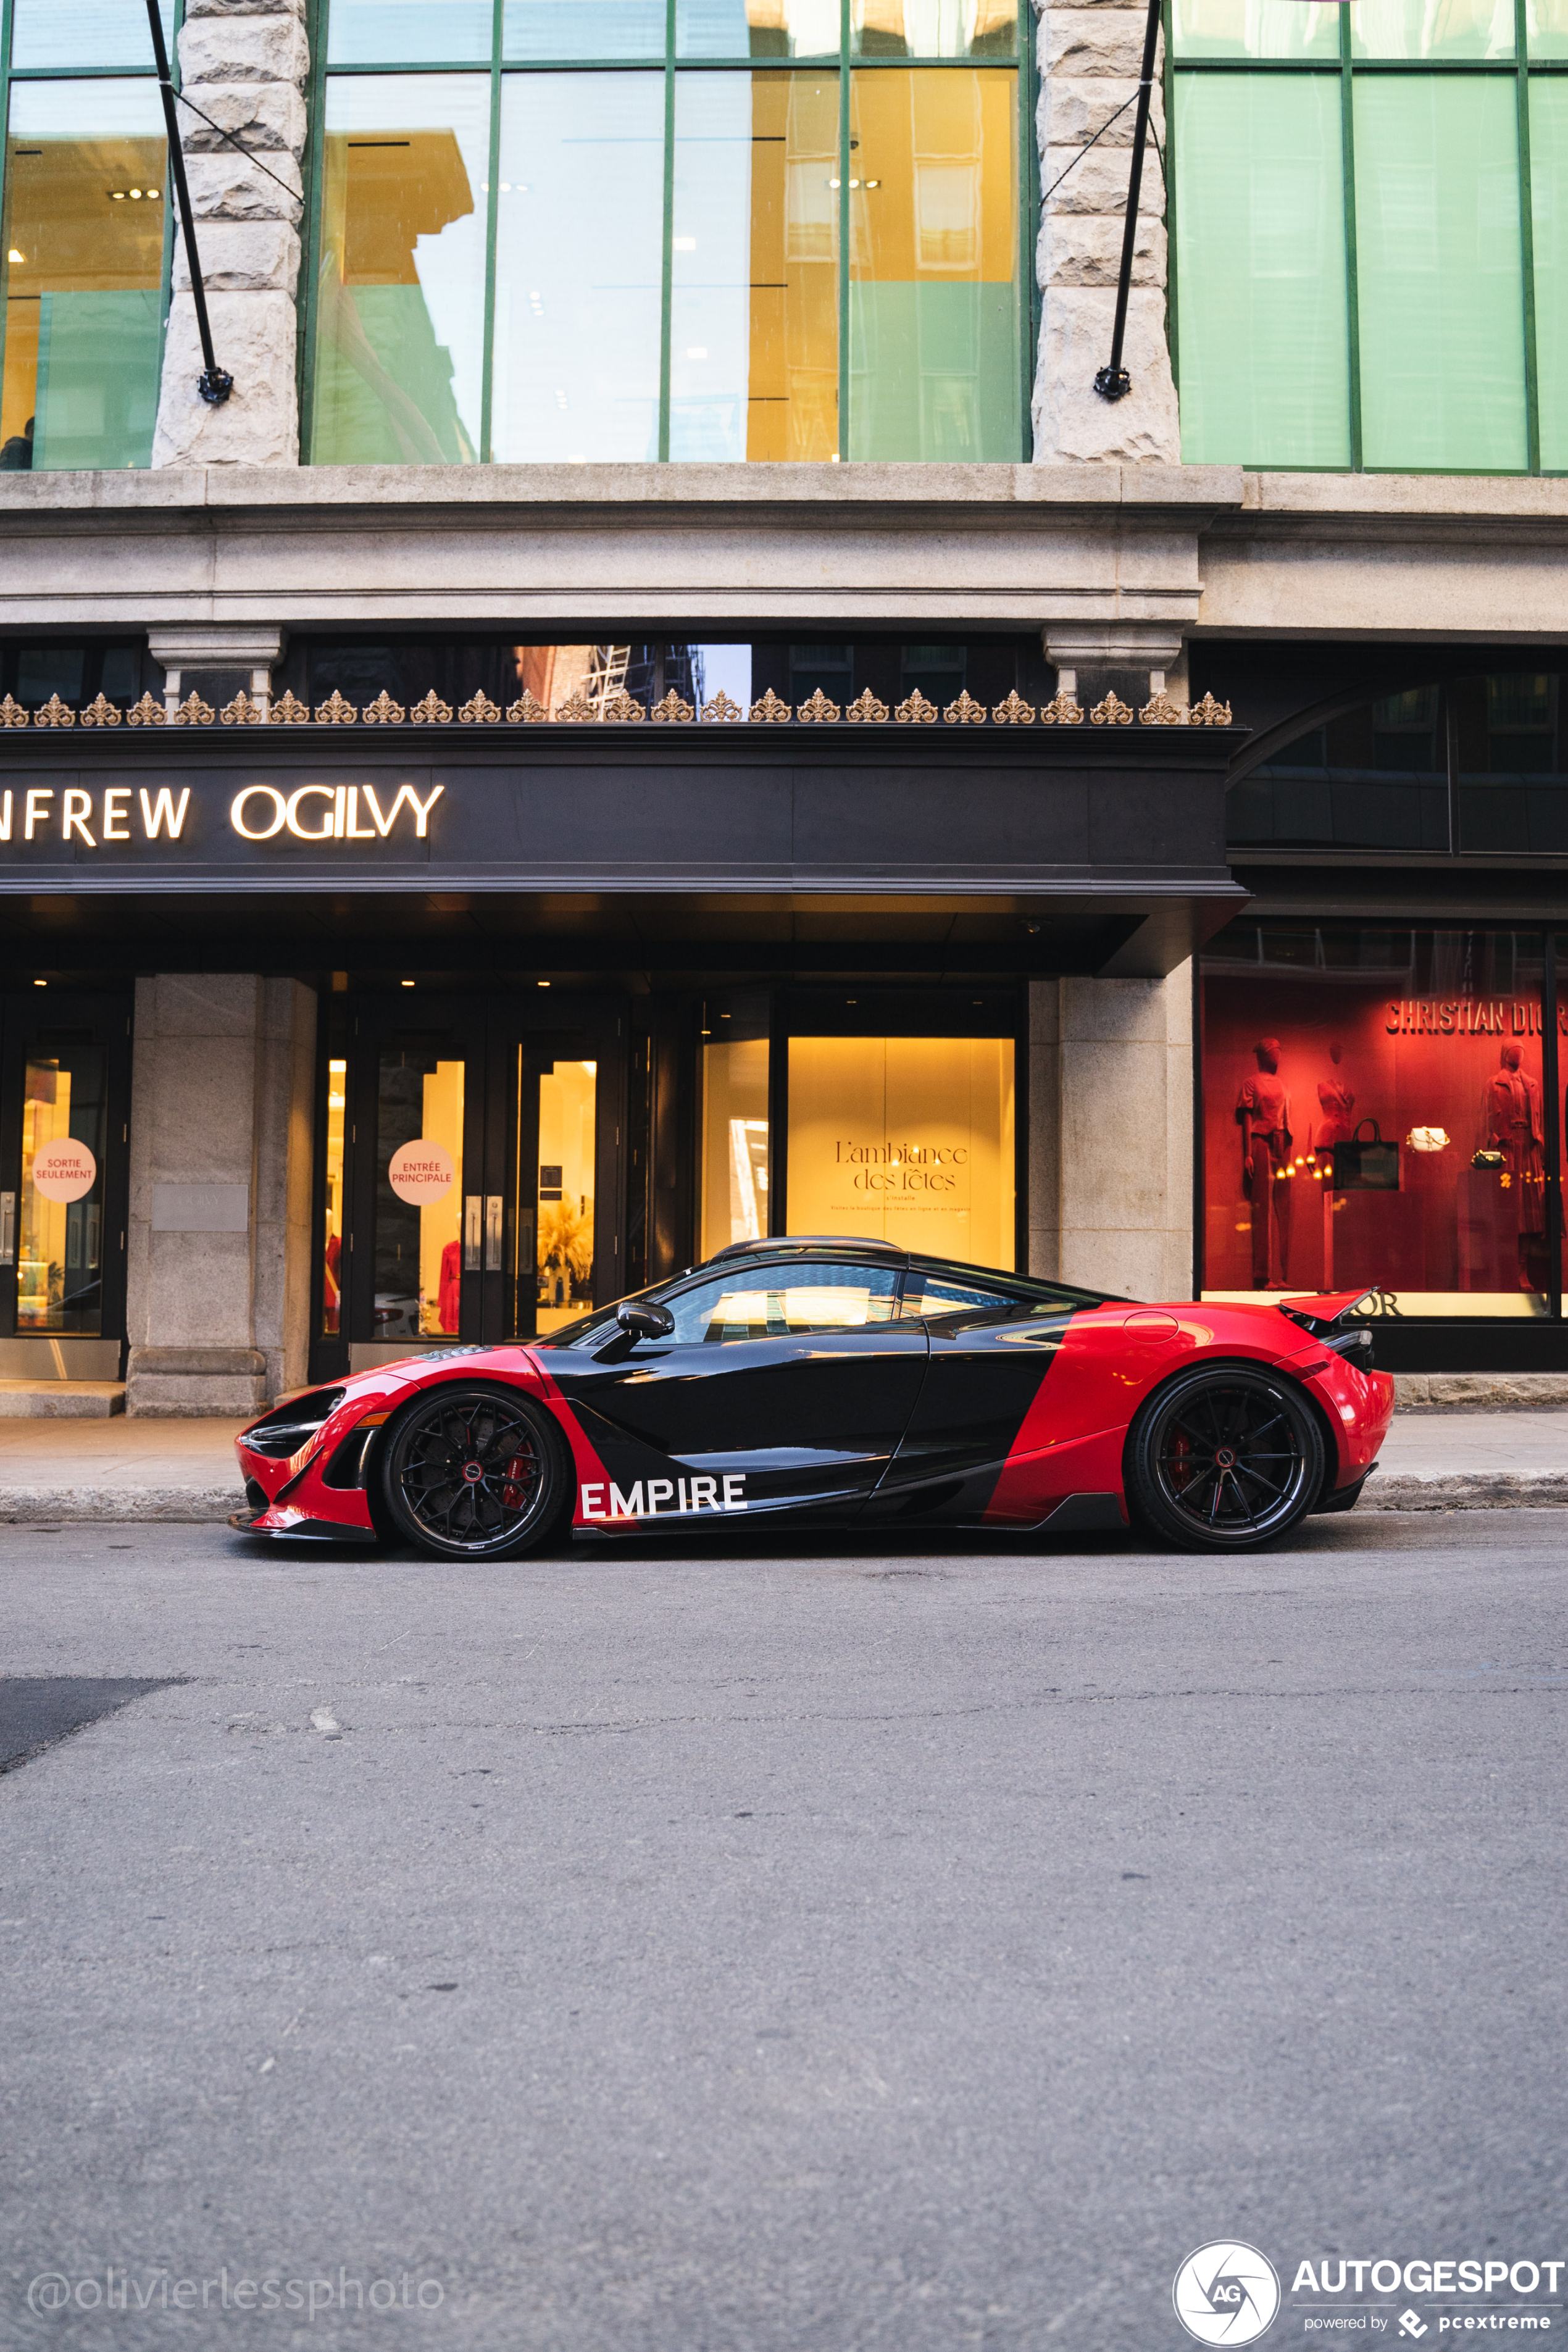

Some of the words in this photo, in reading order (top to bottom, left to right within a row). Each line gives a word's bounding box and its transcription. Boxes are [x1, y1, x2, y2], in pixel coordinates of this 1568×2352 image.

[231, 785, 445, 839] OGILVY
[1385, 1001, 1504, 1034] CHRISTIAN
[47, 1159, 81, 1168] SORTIE
[403, 1161, 441, 1172] ENTRÉE
[36, 1170, 92, 1179] SEULEMENT
[392, 1174, 452, 1183] PRINCIPALE
[854, 1169, 896, 1190] des
[902, 1169, 956, 1190] fêtes
[582, 1473, 748, 1519] EMPIRE
